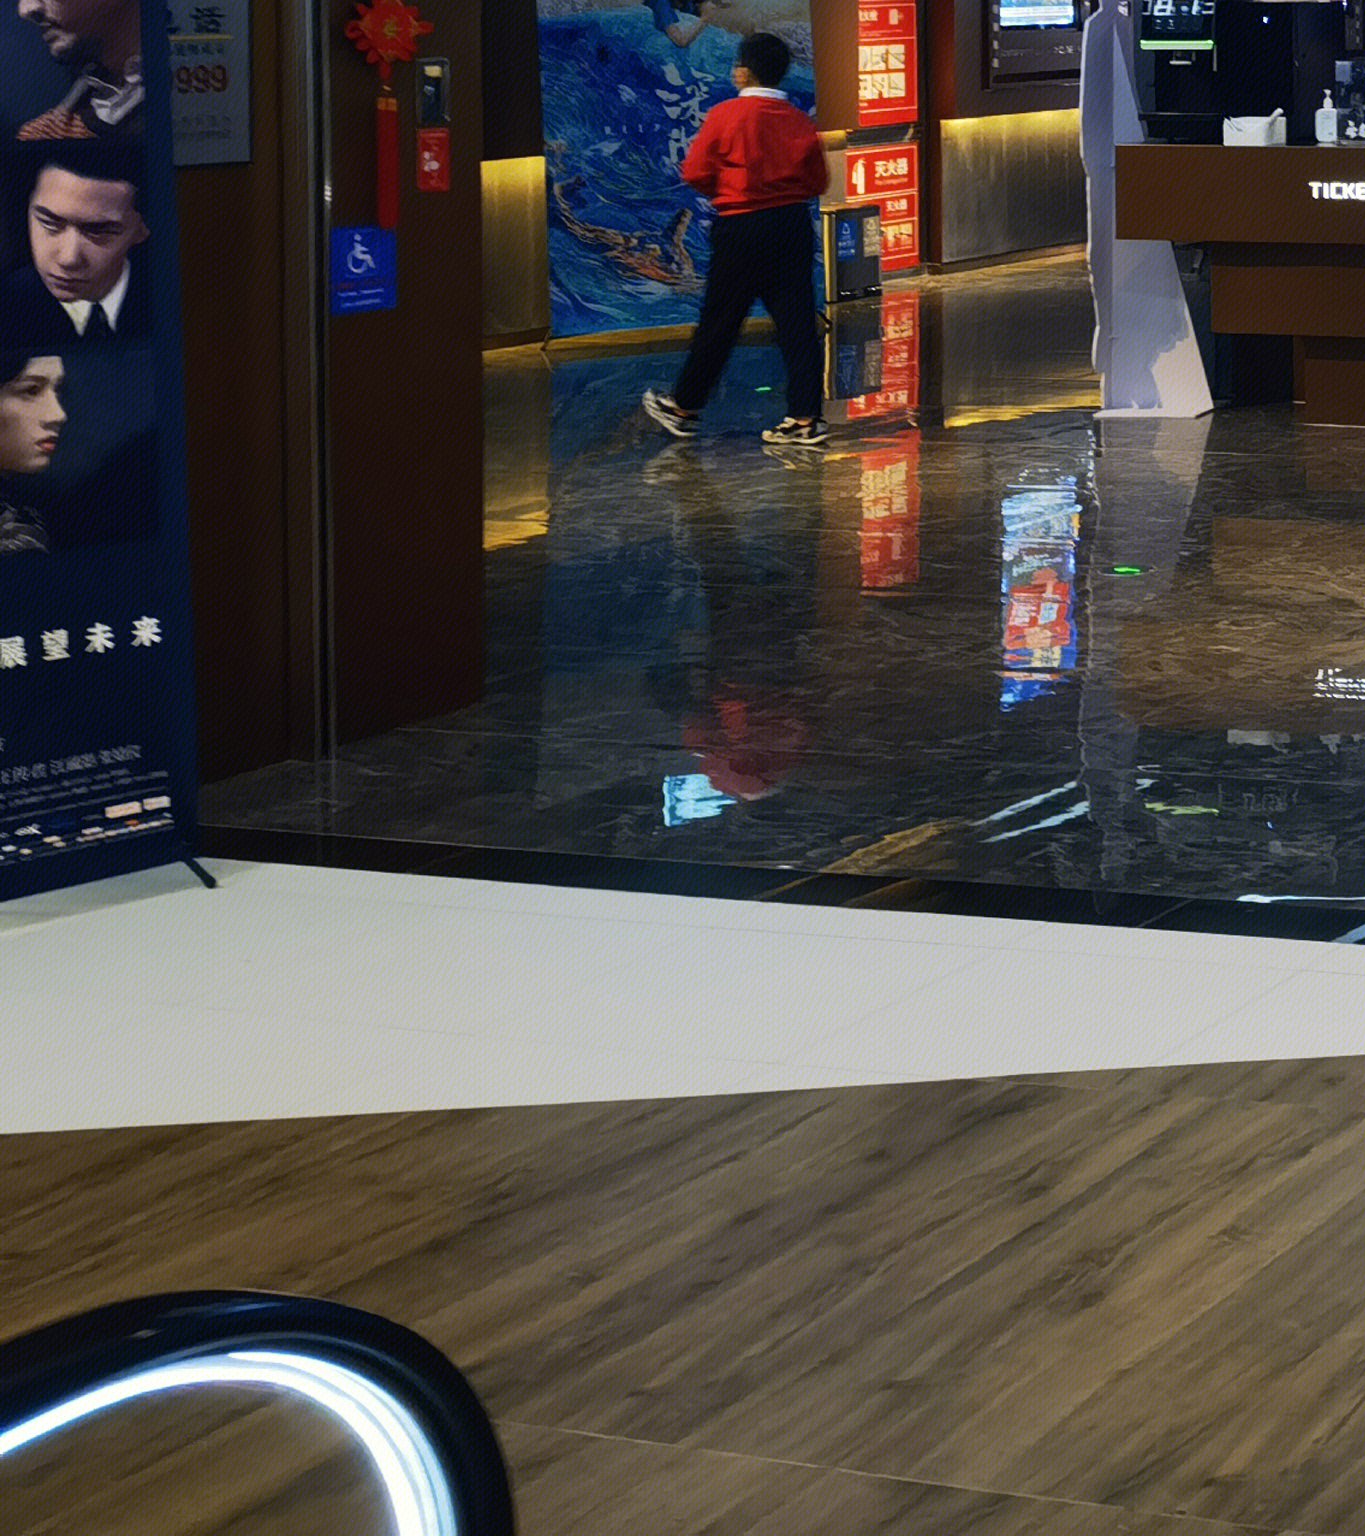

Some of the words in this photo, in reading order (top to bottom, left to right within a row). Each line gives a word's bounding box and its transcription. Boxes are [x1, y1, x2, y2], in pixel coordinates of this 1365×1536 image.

[874, 156, 909, 178] 灭火器
[0, 614, 163, 670] 展望未来
